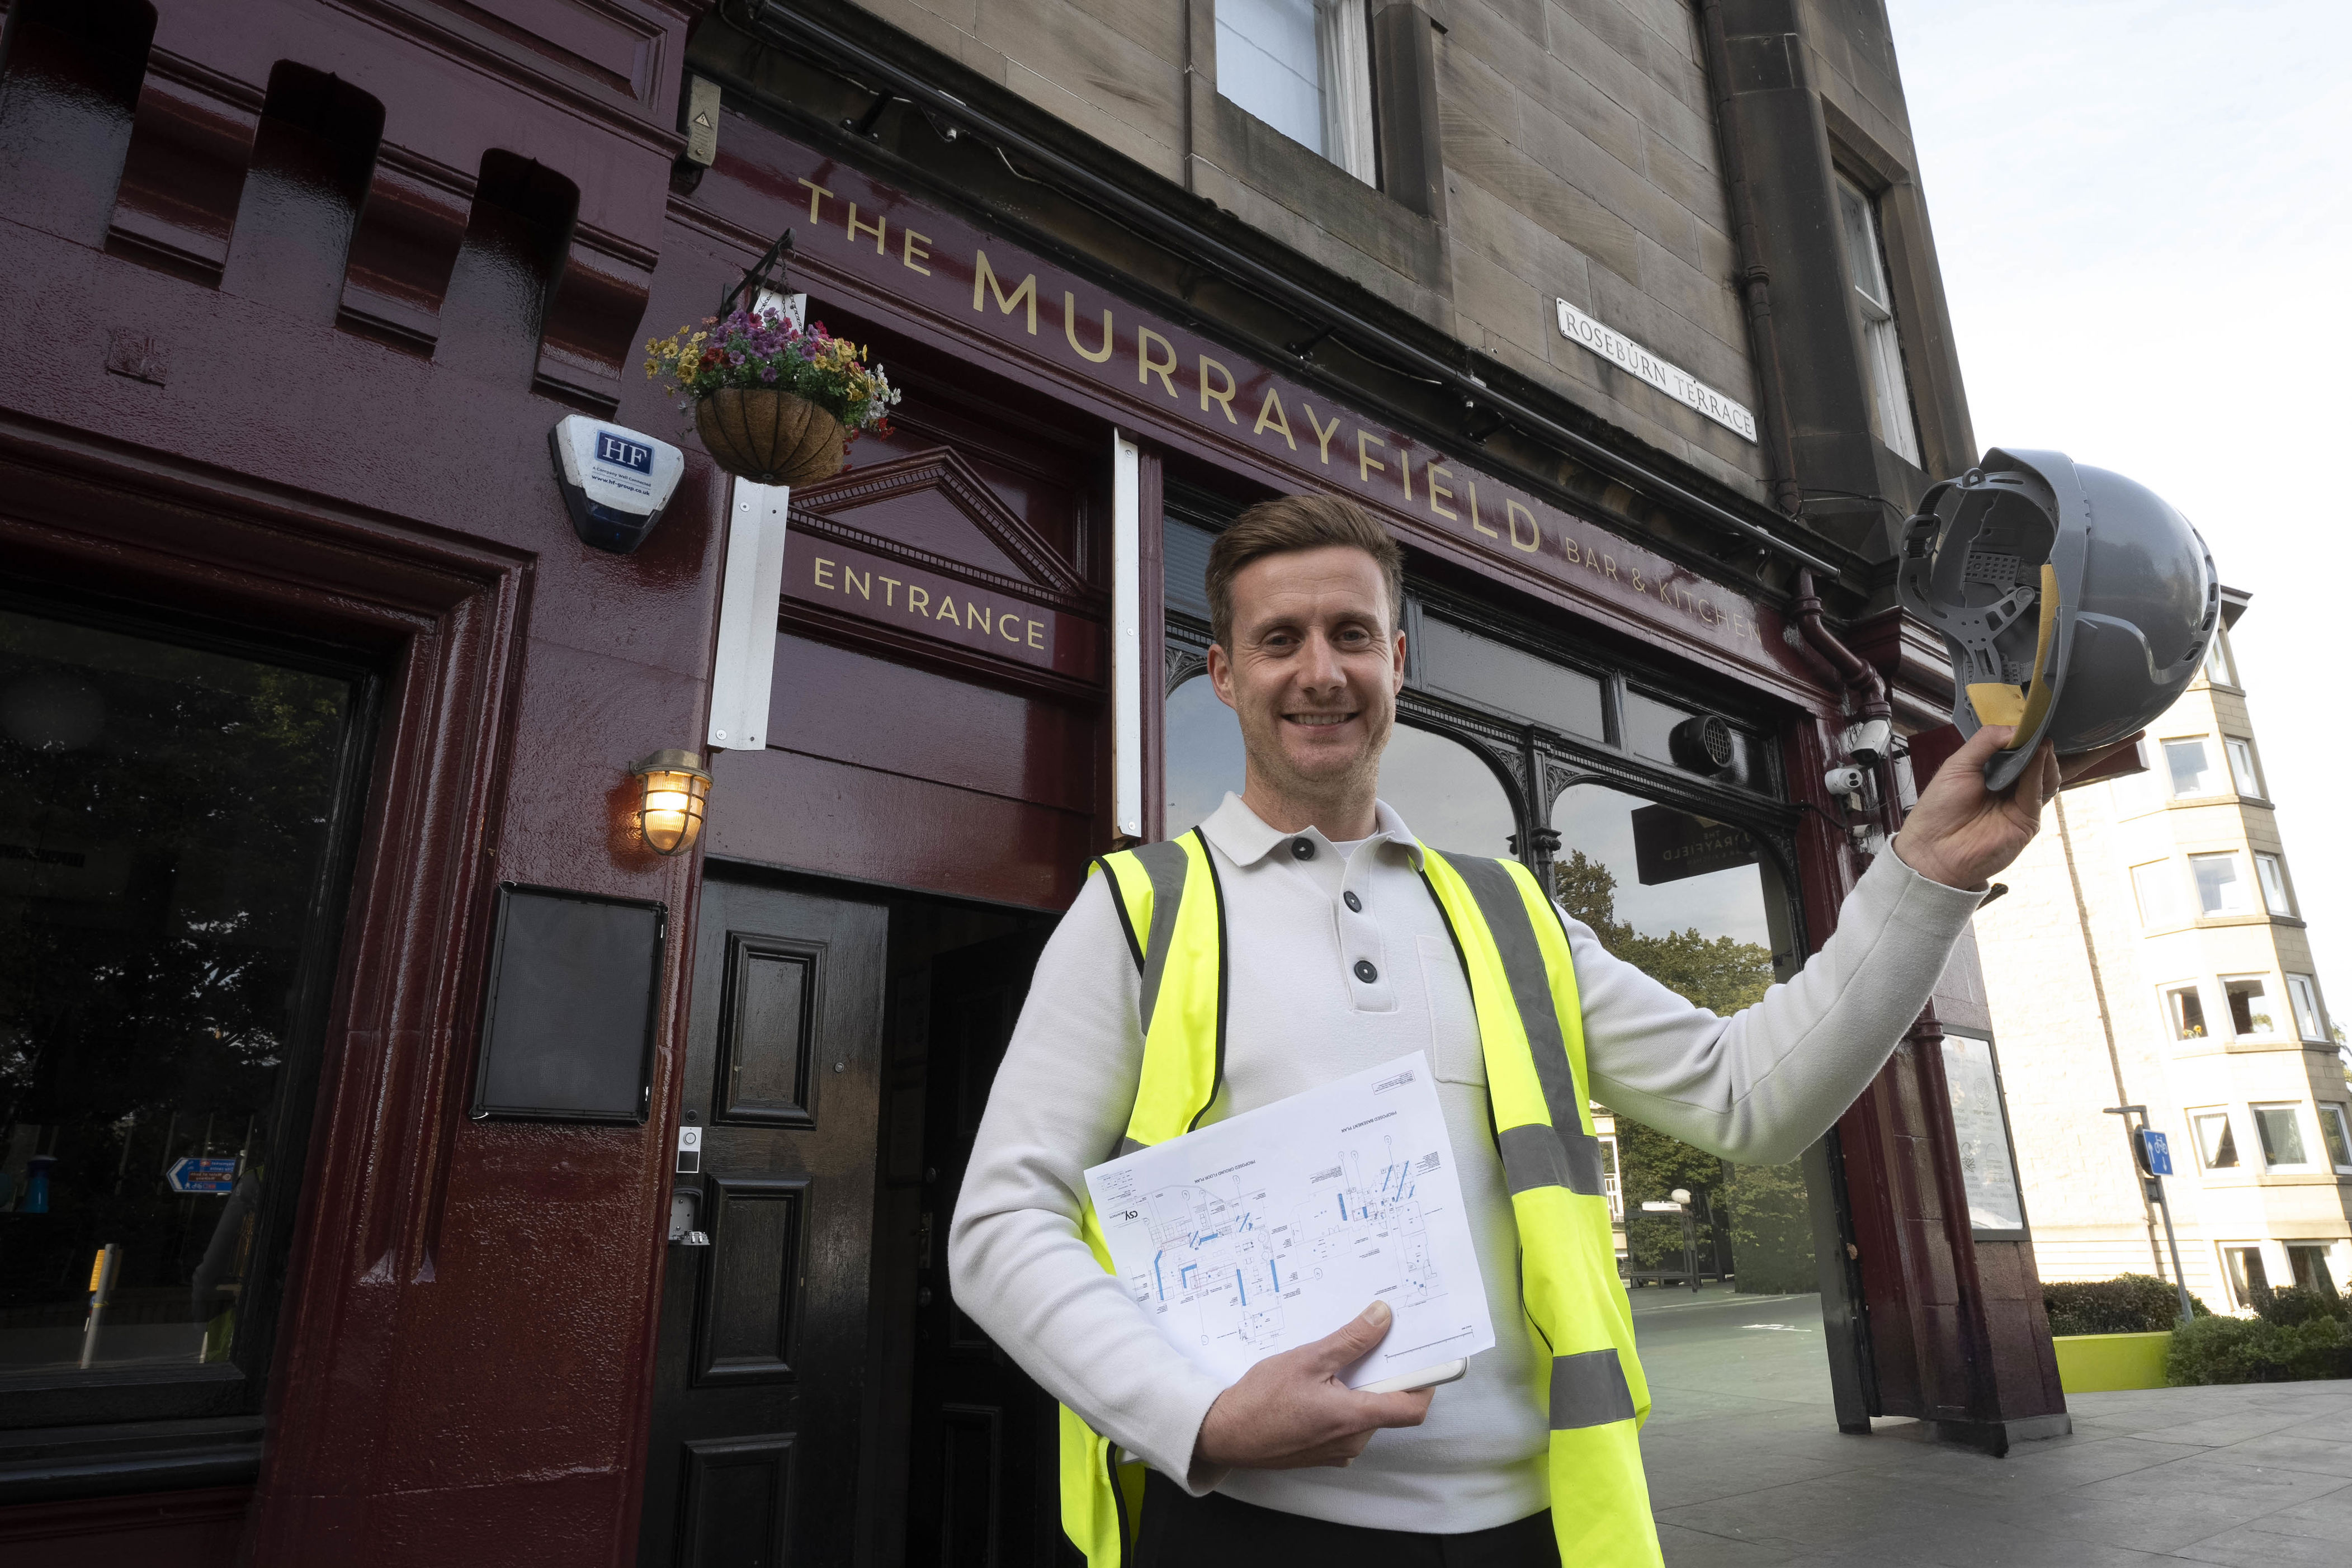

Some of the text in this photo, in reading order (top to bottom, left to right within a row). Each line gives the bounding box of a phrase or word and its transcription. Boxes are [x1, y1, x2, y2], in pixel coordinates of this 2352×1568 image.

[1565, 310, 1752, 435] ROSEBURN TERRACE
[798, 177, 1761, 643] THE MURRAYFIELD BAR & KITCHEN
[602, 437, 647, 467] HF
[592, 475, 650, 496] www.hf-group.co.uk
[597, 467, 617, 477] Company
[629, 476, 651, 487] Connected
[814, 557, 1045, 650] ENTRANCE
[1352, 1118, 1373, 1129] BASEMENT
[1373, 1111, 1396, 1121] PROPOSED
[1217, 1166, 1234, 1175] GROUND
[1234, 1159, 1255, 1170] PROPOSED
